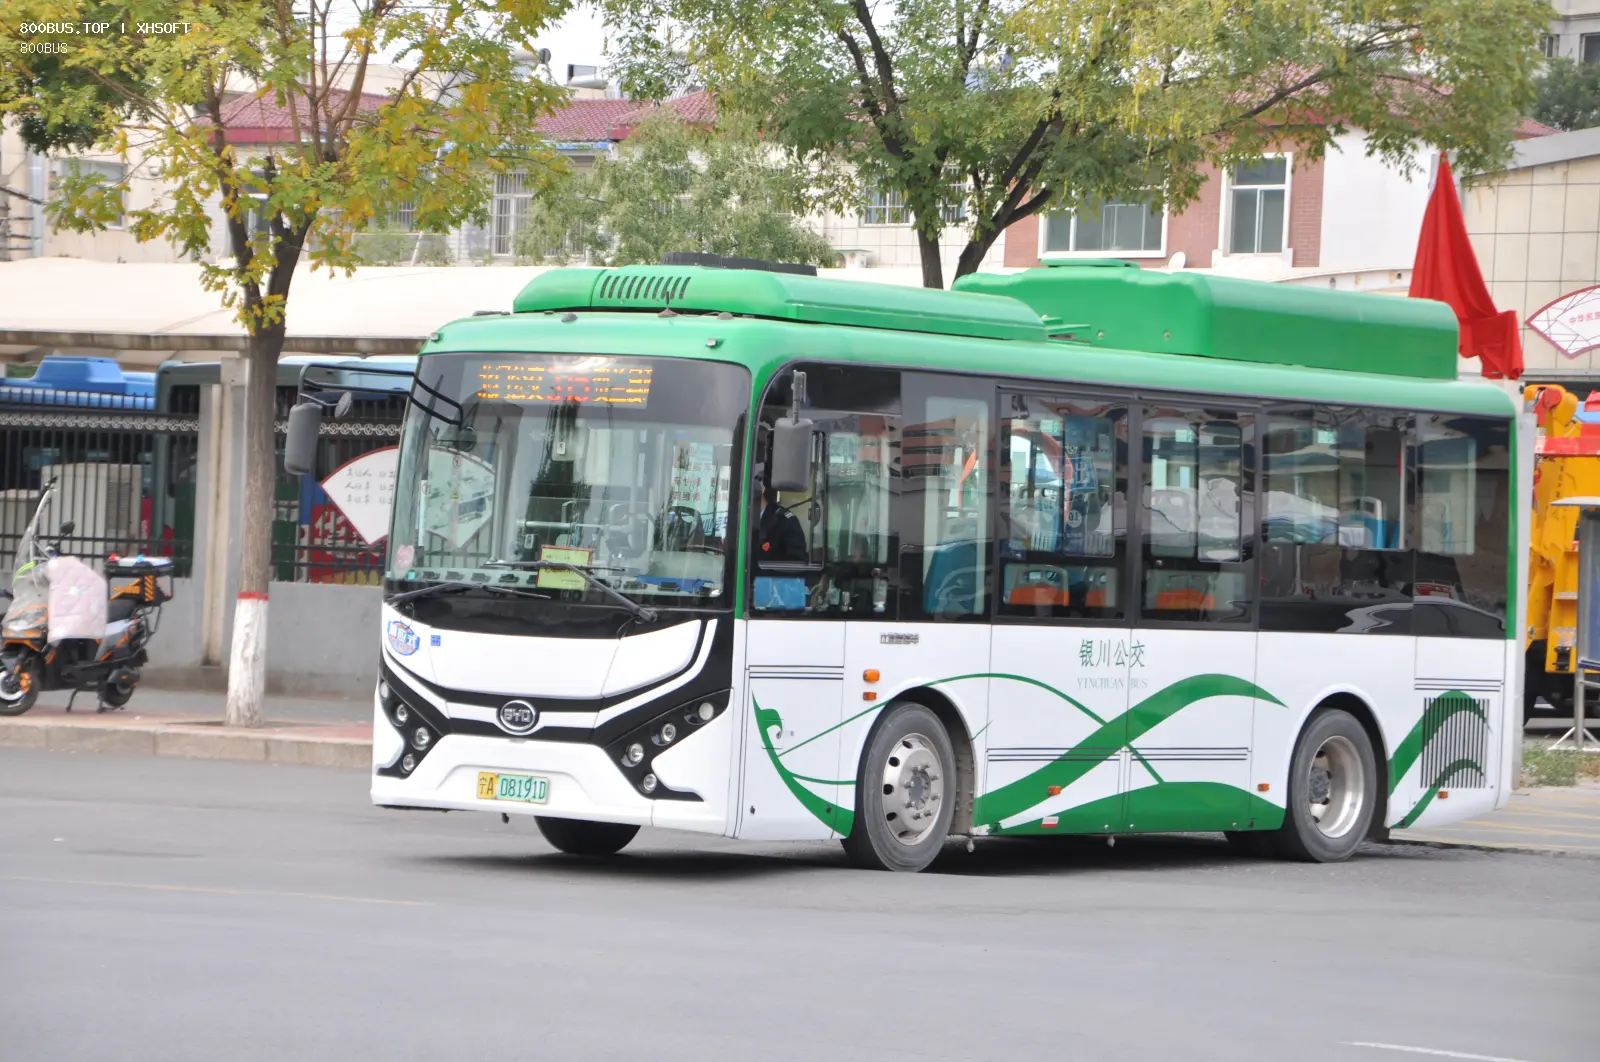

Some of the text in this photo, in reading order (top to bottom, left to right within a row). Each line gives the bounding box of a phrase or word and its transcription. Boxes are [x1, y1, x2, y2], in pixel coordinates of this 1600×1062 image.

[1079, 639, 1145, 668] 银川公交
[1077, 677, 1148, 689] YINCHUAN BUS
[503, 708, 531, 723] BYD
